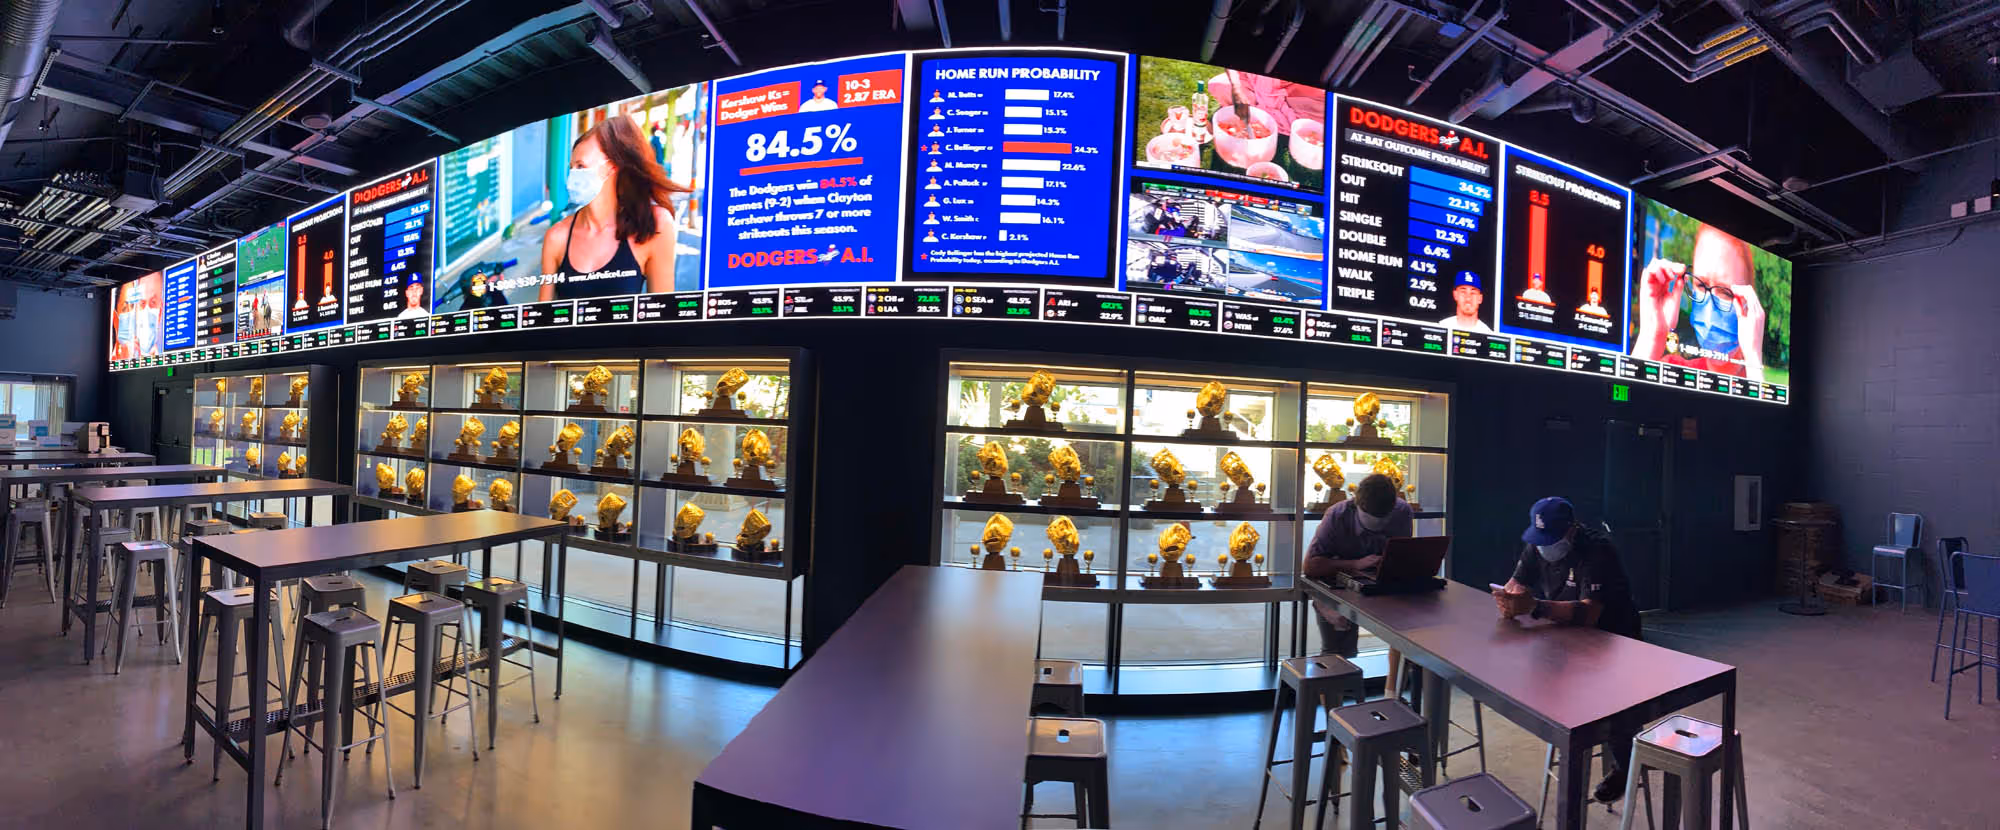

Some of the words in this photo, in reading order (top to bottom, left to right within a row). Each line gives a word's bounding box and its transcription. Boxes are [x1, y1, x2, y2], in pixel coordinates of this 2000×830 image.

[845, 79, 870, 90] 10-3
[936, 69, 976, 80] HOME
[979, 68, 1009, 78] RUN
[1012, 68, 1100, 80] PROBABILITY
[721, 95, 766, 109] Kershaw
[844, 91, 870, 103] 2.87
[872, 90, 896, 100] ERA
[721, 107, 758, 120] Dodger
[761, 102, 788, 113] Wins
[746, 123, 857, 162] 84.5%
[1350, 106, 1439, 145] DODGERS
[1459, 137, 1488, 160] A.I.
[1351, 132, 1384, 146] AT-BAT
[1385, 140, 1430, 159] OUTCOME
[1432, 152, 1488, 174] PROBABILITY
[729, 188, 747, 197] The
[749, 184, 794, 196] Dodgers
[796, 180, 818, 190] win
[820, 177, 857, 189] 84.5%
[859, 175, 873, 186] of
[1341, 154, 1404, 177] STRIKEOUT
[1459, 181, 1491, 199] 34.2%
[1340, 173, 1366, 187] OUT
[1448, 197, 1480, 212] 22.1%
[728, 202, 762, 215] games
[764, 197, 792, 210] (9-2)
[793, 195, 825, 205] when
[827, 193, 872, 205] Clayton
[1340, 192, 1360, 204] HIT
[1446, 213, 1476, 229] 17.4%
[728, 215, 774, 226] Kershaw
[775, 210, 814, 221] throws
[816, 210, 823, 219] 7
[826, 210, 838, 218] or
[841, 208, 872, 217] more
[1339, 210, 1382, 227] SINGLE
[1435, 228, 1466, 244] 12.3%
[738, 226, 790, 240] strikeouts
[792, 225, 812, 235] this
[814, 224, 857, 234] season.
[1339, 229, 1387, 246] DOUBLE
[1423, 244, 1450, 258] 6.4%
[1587, 244, 1606, 259] 4.0
[728, 249, 818, 268] DODGERS
[841, 247, 873, 263] A.I.
[1338, 248, 1376, 263] HOME
[1377, 254, 1403, 268] RUN
[1410, 260, 1437, 274] 4.1%
[1338, 266, 1373, 282] WALK
[1410, 278, 1437, 292] 2.9%
[1337, 286, 1375, 300] TRIPLE
[1409, 296, 1437, 309] 0.6%
